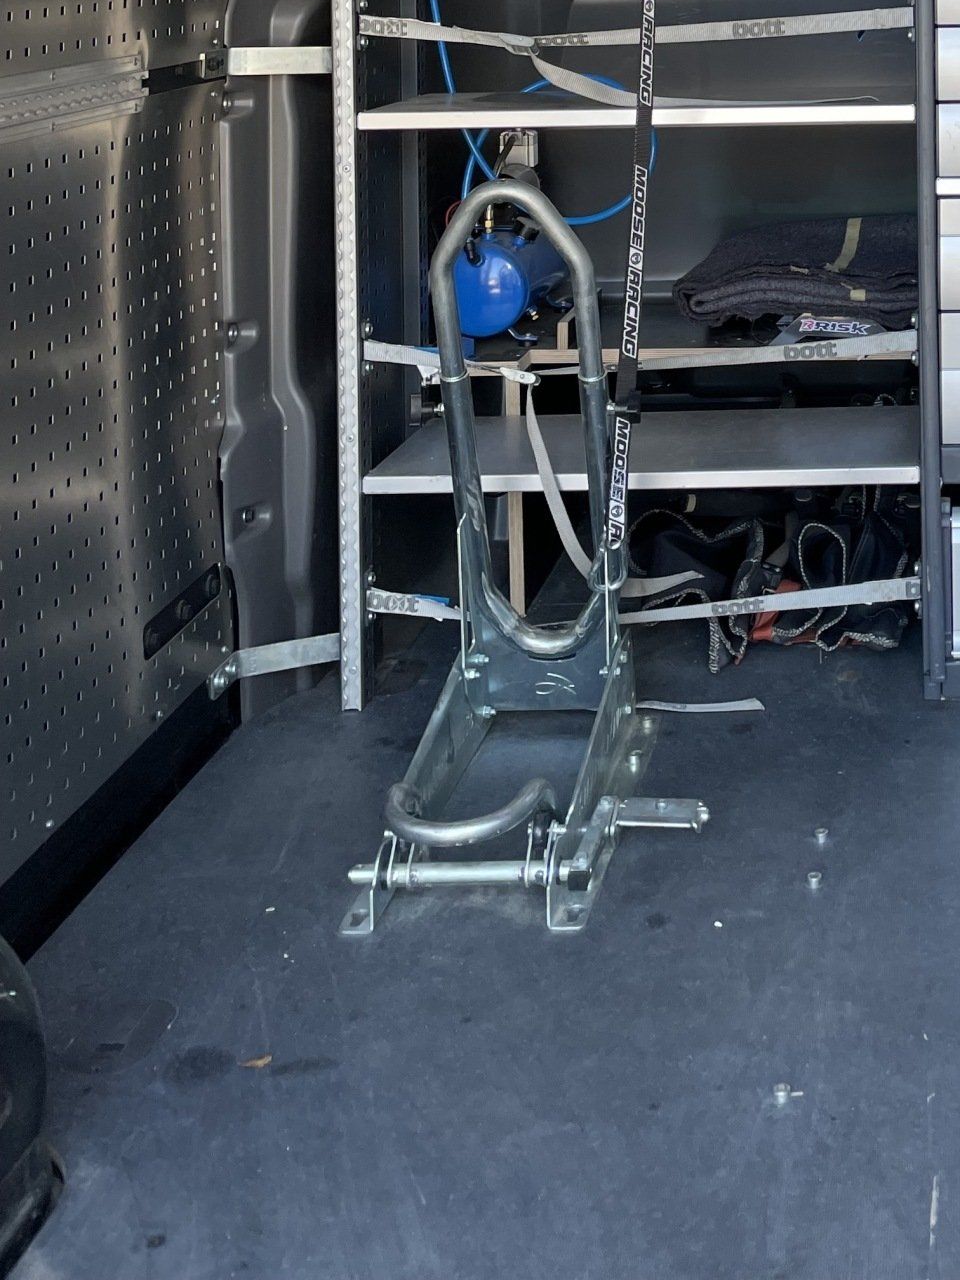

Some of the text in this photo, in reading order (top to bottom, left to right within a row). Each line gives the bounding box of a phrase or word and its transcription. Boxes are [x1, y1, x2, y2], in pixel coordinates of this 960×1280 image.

[640, 14, 655, 107] RACING
[622, 164, 648, 359] MOOSE RACING
[610, 416, 631, 504] MOOSE
